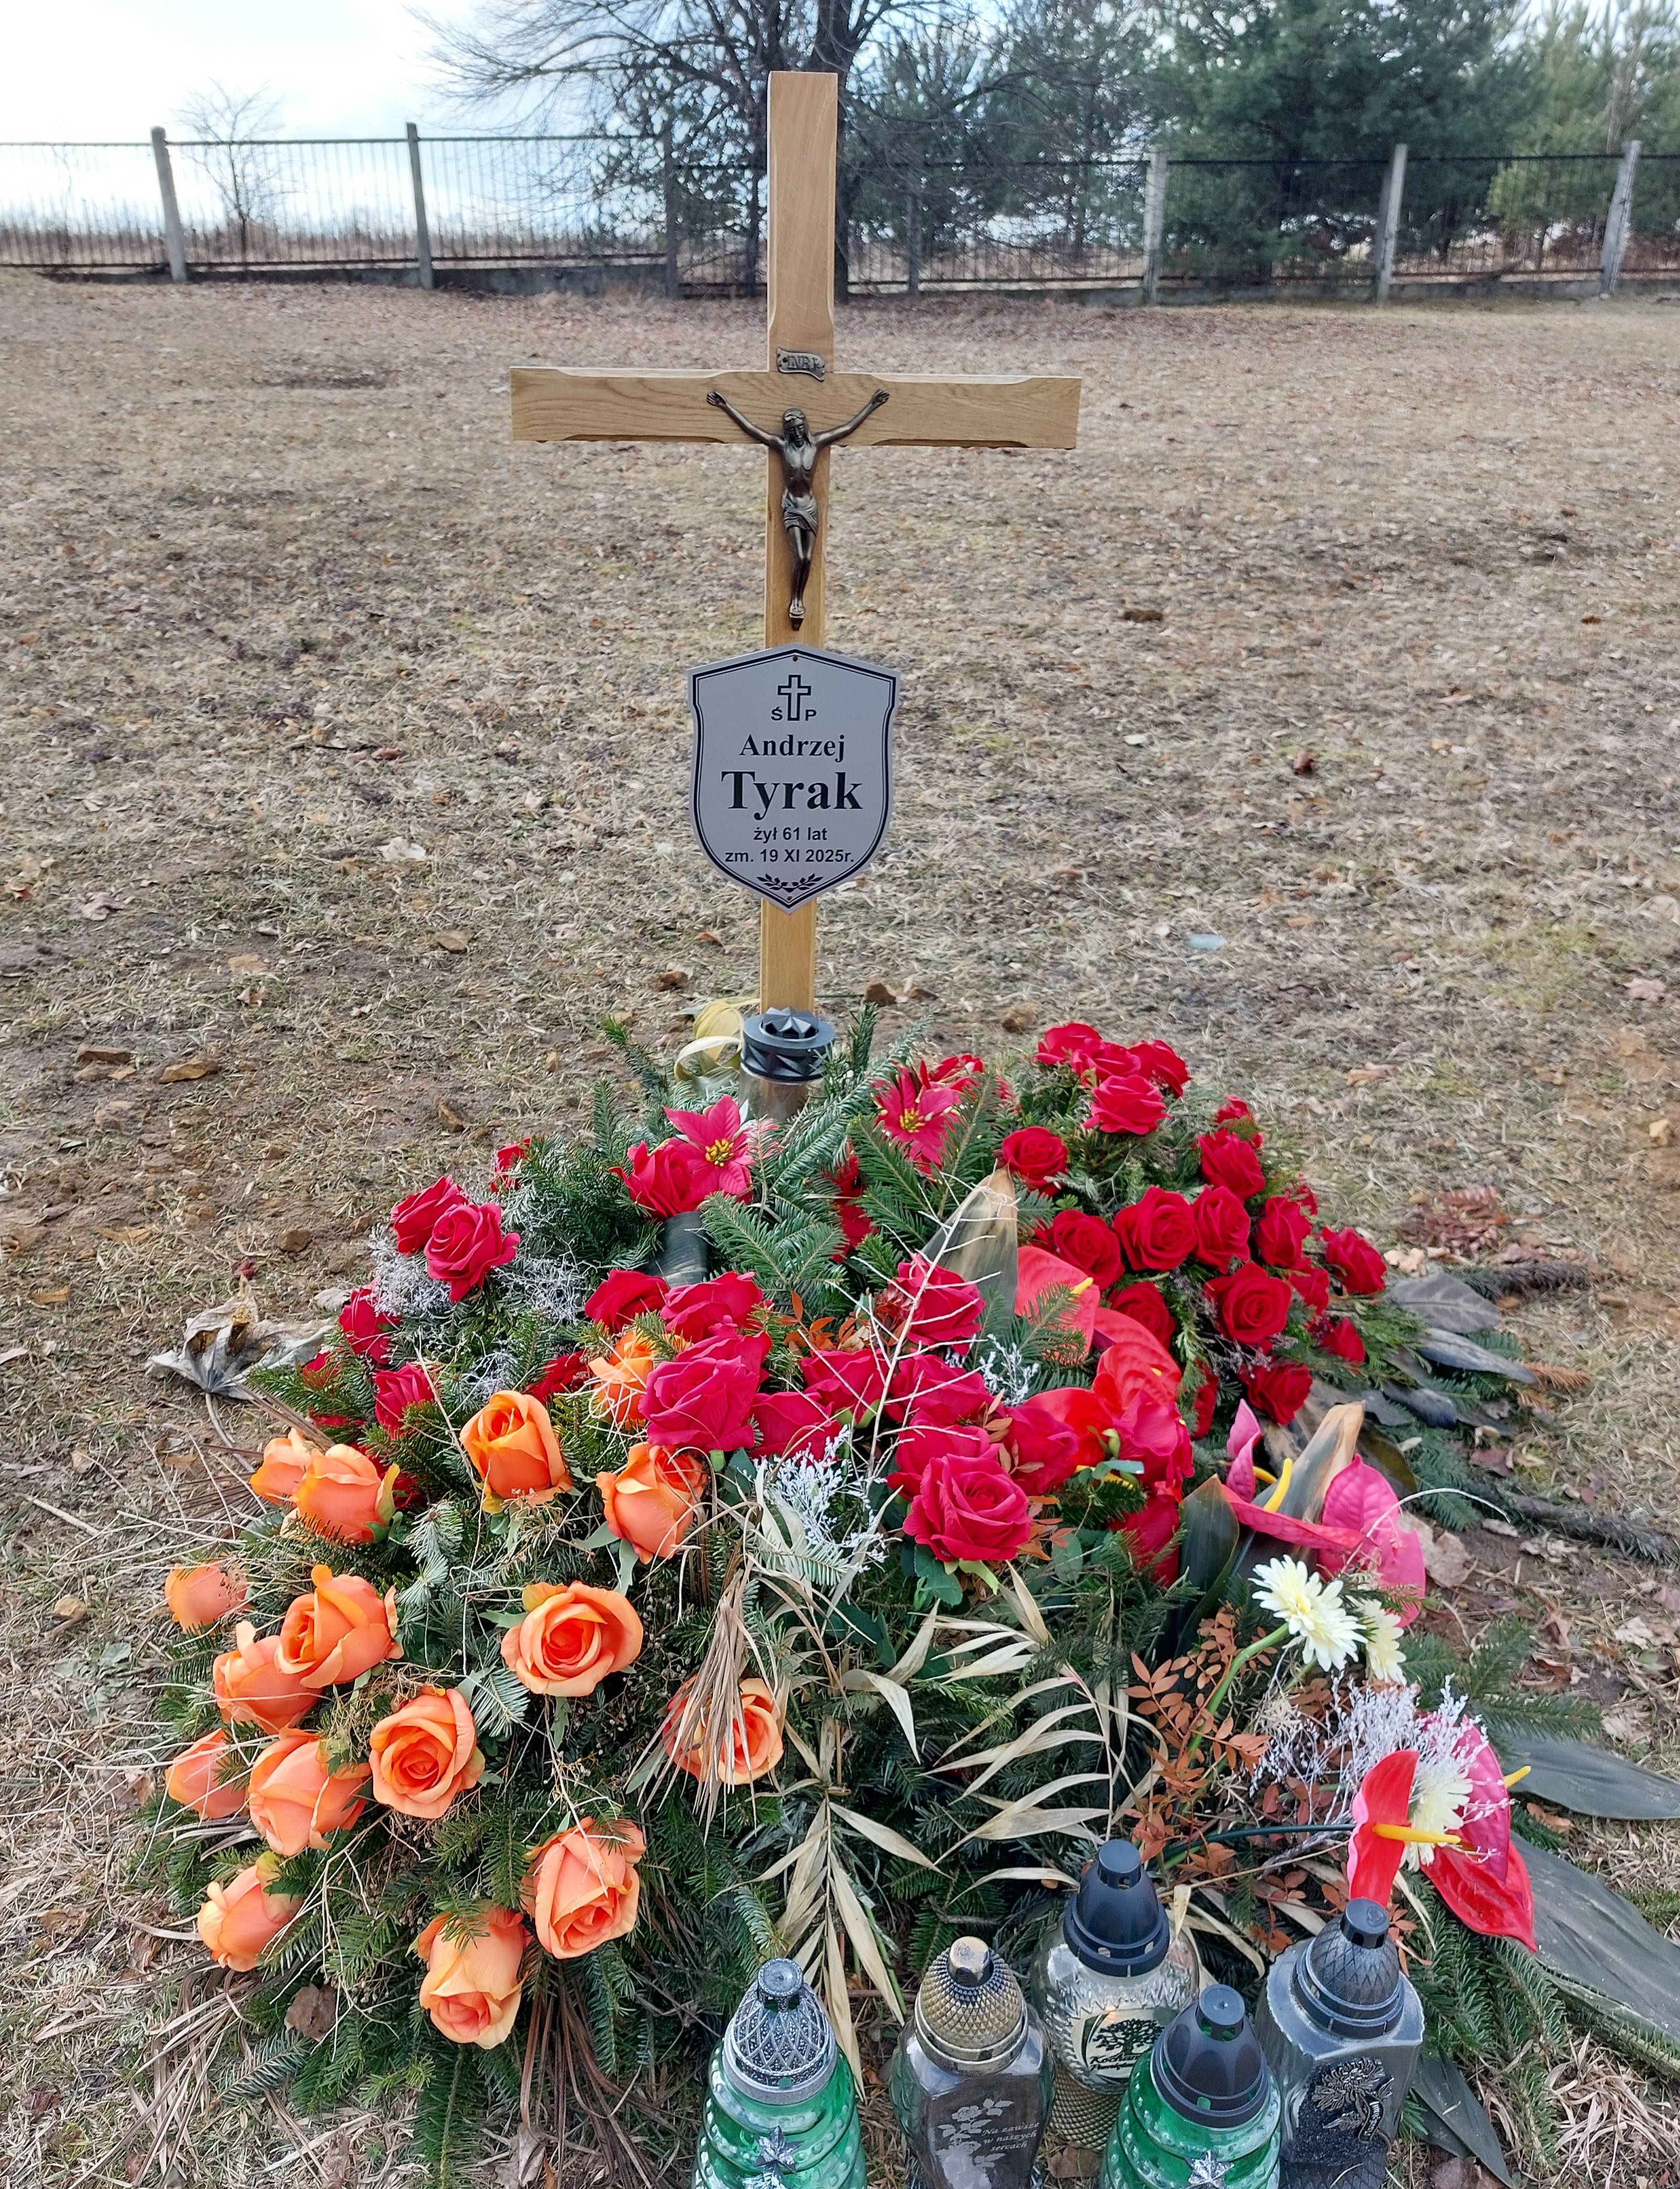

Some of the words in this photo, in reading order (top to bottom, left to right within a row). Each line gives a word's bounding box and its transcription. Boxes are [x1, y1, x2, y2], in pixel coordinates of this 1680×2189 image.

[771, 706, 783, 721] Ś
[805, 709, 817, 722] P
[738, 734, 845, 763] Andrzej
[721, 771, 863, 821] Tyrak
[753, 827, 778, 844] żył
[782, 827, 800, 841] 61
[807, 827, 827, 841] lat
[725, 852, 754, 862] zm.
[760, 849, 779, 862] 19
[783, 849, 800, 862] XI
[805, 849, 854, 863] 2025r.
[982, 2128, 998, 2136] Na
[1001, 2122, 1039, 2132] zawsze
[996, 2130, 1038, 2142] naszych
[990, 2141, 1027, 2152] sercach
